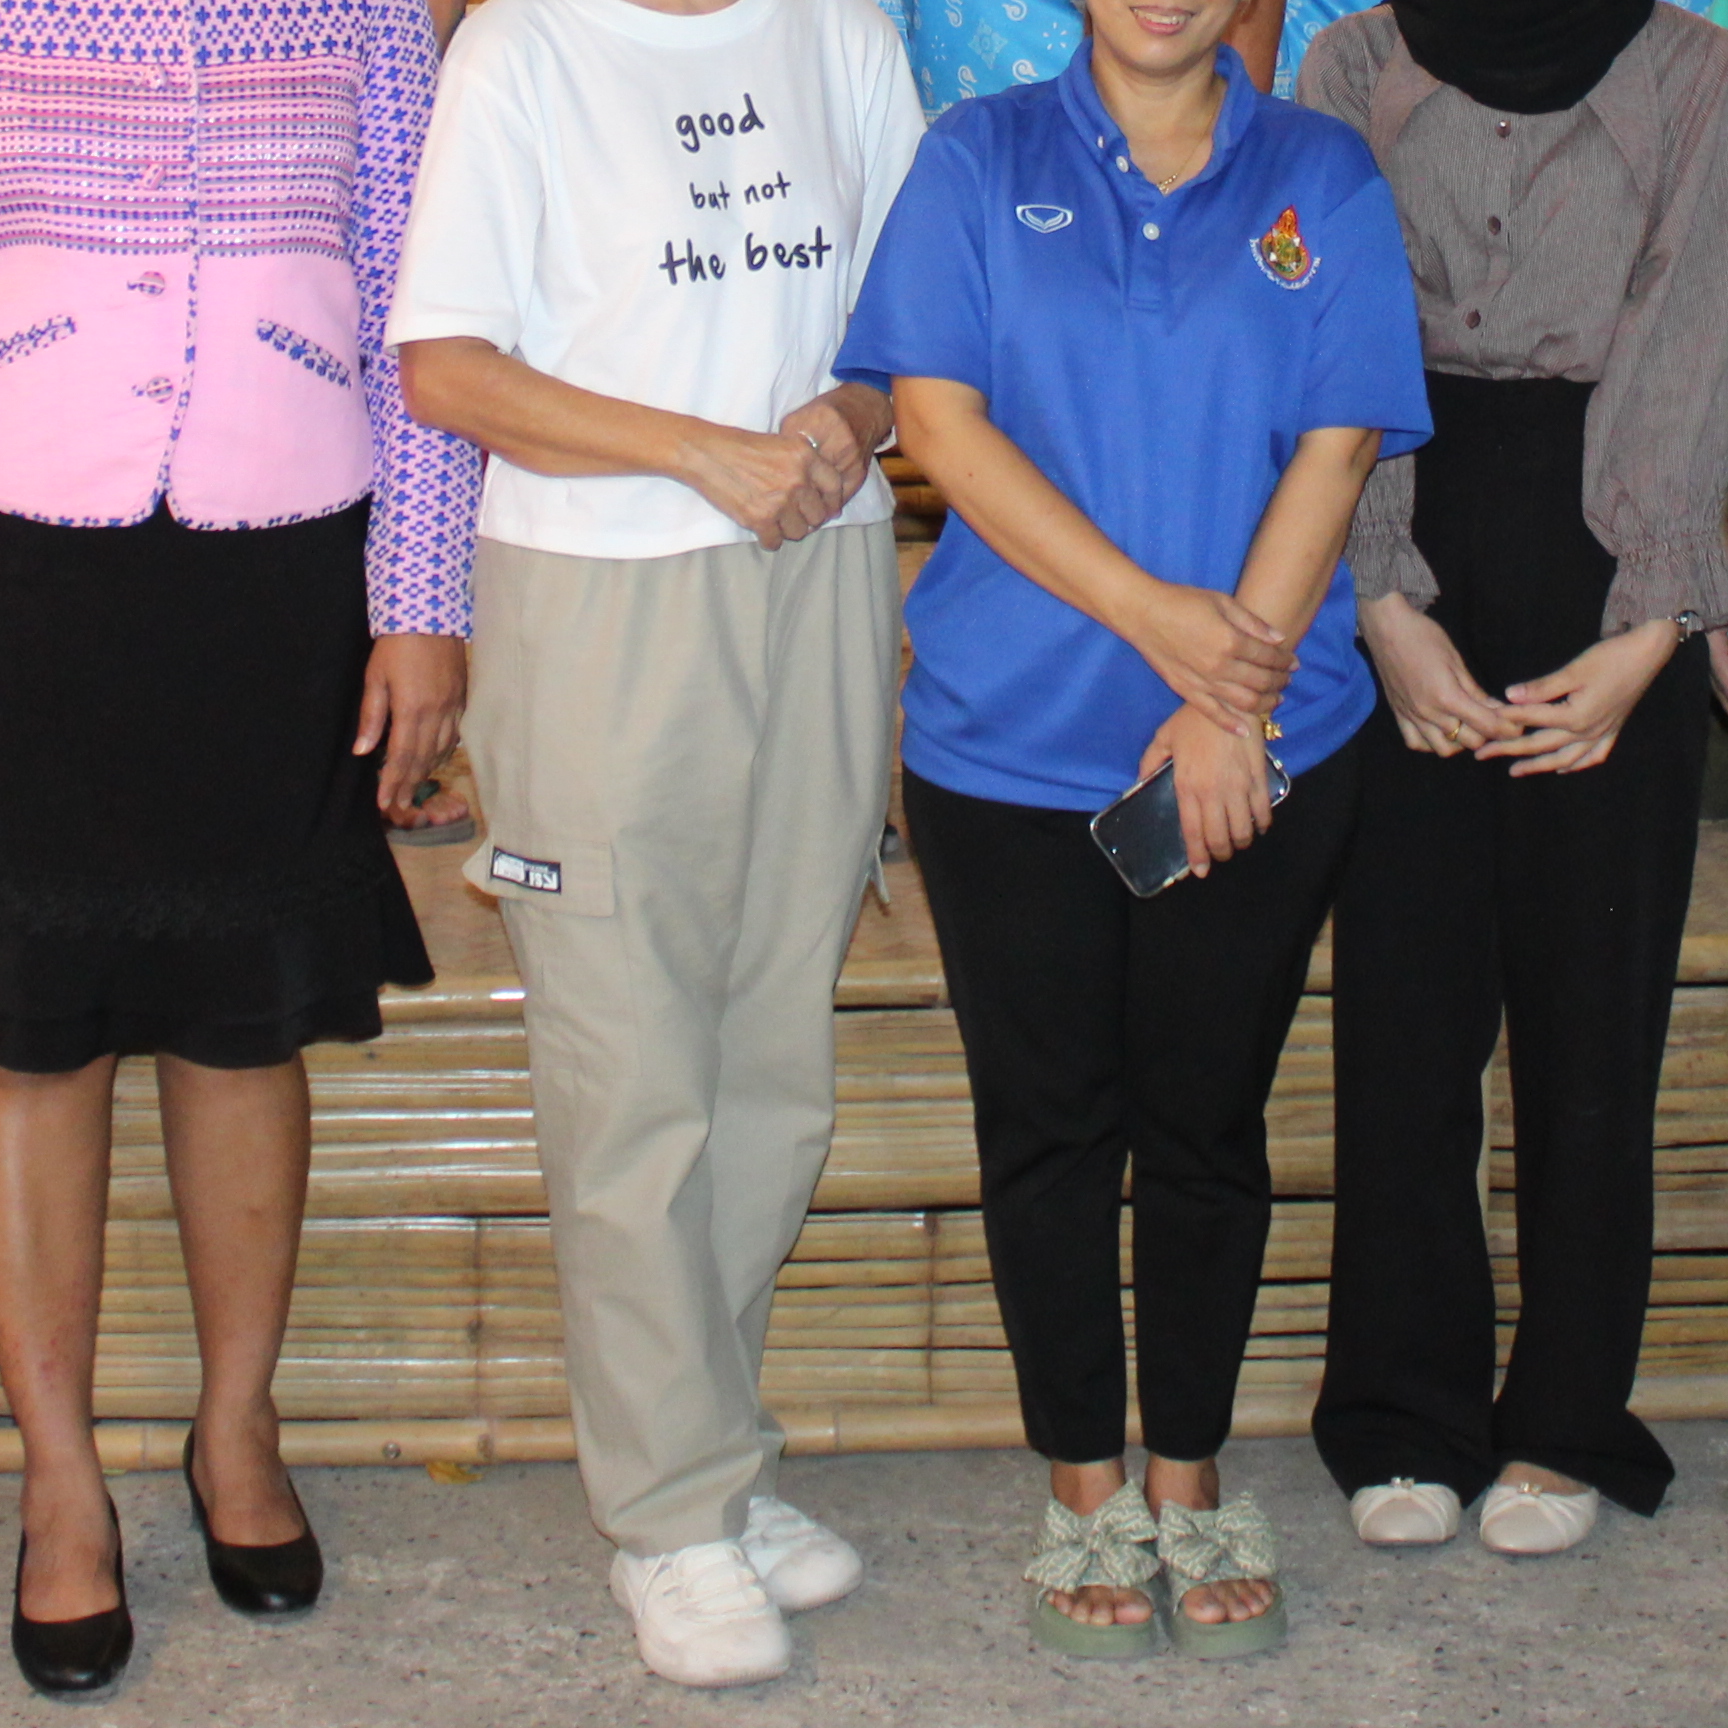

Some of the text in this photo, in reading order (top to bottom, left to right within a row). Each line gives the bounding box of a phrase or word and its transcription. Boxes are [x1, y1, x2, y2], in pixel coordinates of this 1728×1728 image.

[674, 92, 765, 153] good
[689, 170, 791, 210] but not
[658, 225, 832, 285] the best
